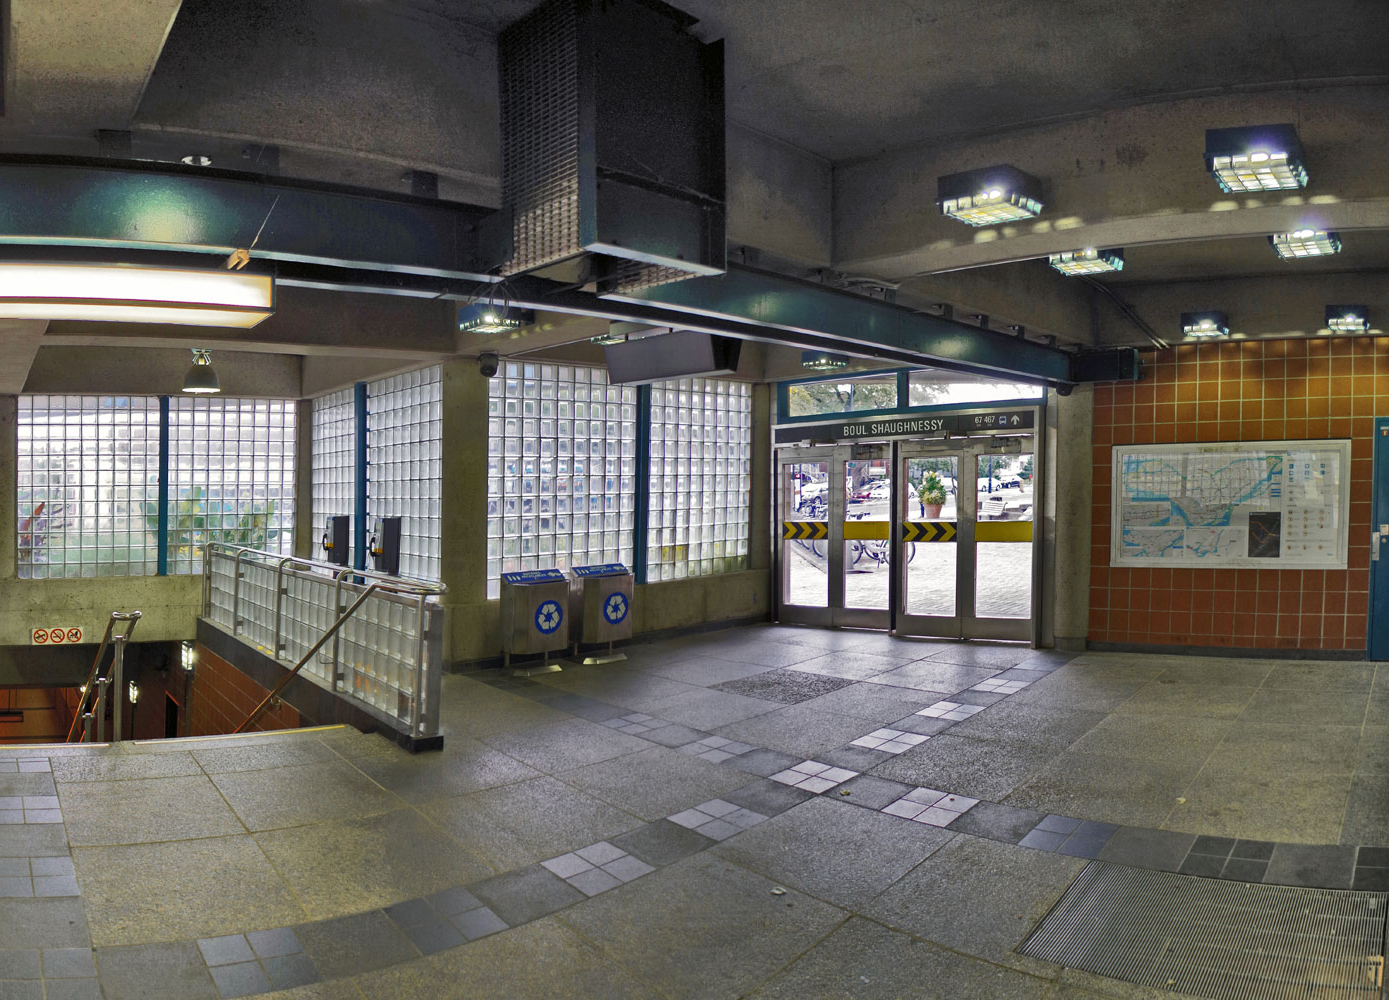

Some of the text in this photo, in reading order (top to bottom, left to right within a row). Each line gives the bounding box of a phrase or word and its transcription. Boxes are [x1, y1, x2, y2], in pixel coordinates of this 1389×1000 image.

[974, 415, 996, 424] 67 467
[843, 419, 944, 436] BOUL. SHAUGHNESSY
